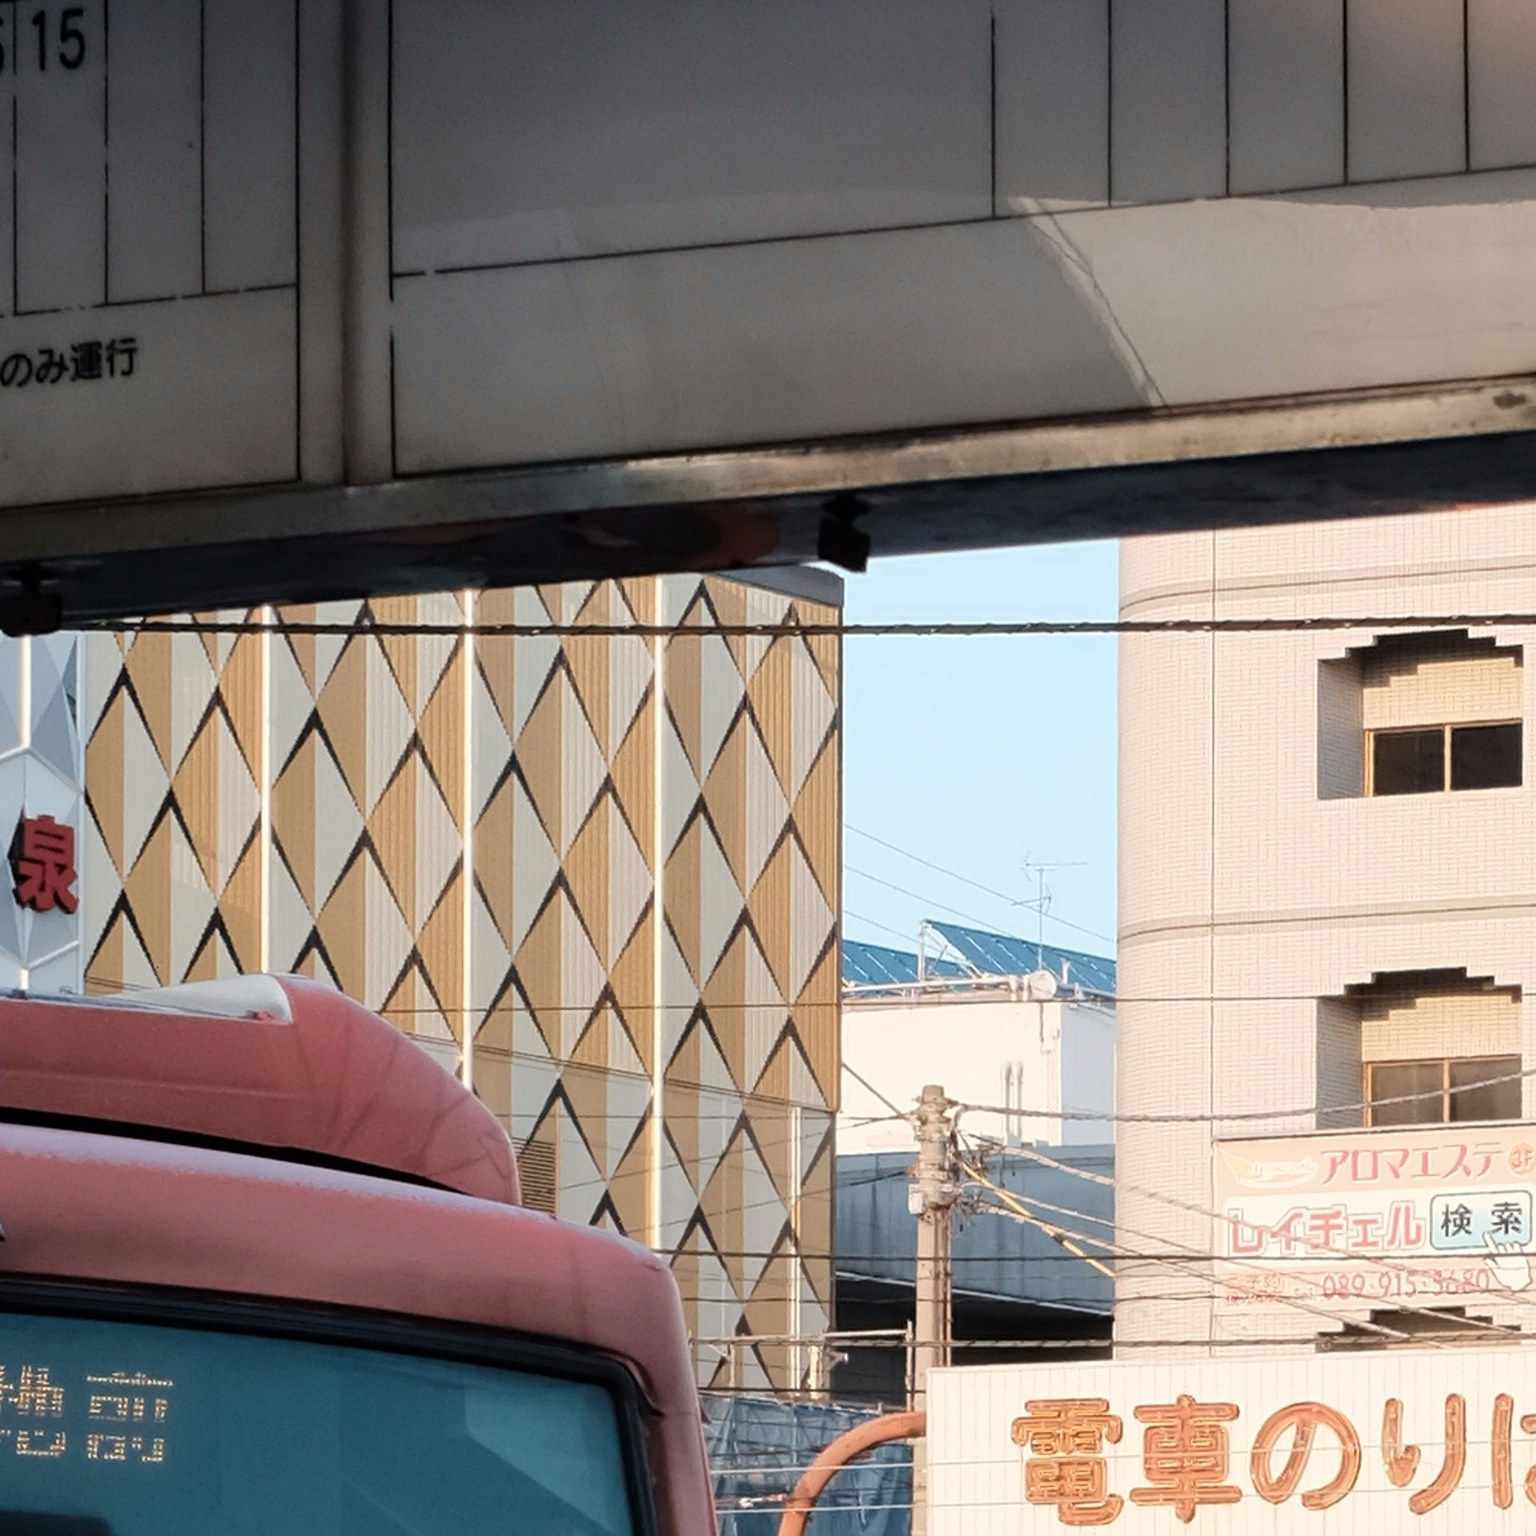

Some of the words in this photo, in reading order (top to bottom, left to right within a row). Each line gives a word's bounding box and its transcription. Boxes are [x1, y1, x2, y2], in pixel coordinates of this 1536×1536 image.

[0, 336, 139, 388] のみ運行
[1321, 1141, 1504, 1185] アロマエステ
[1229, 1203, 1425, 1253] レイチェル
[1441, 1202, 1523, 1237] 検索
